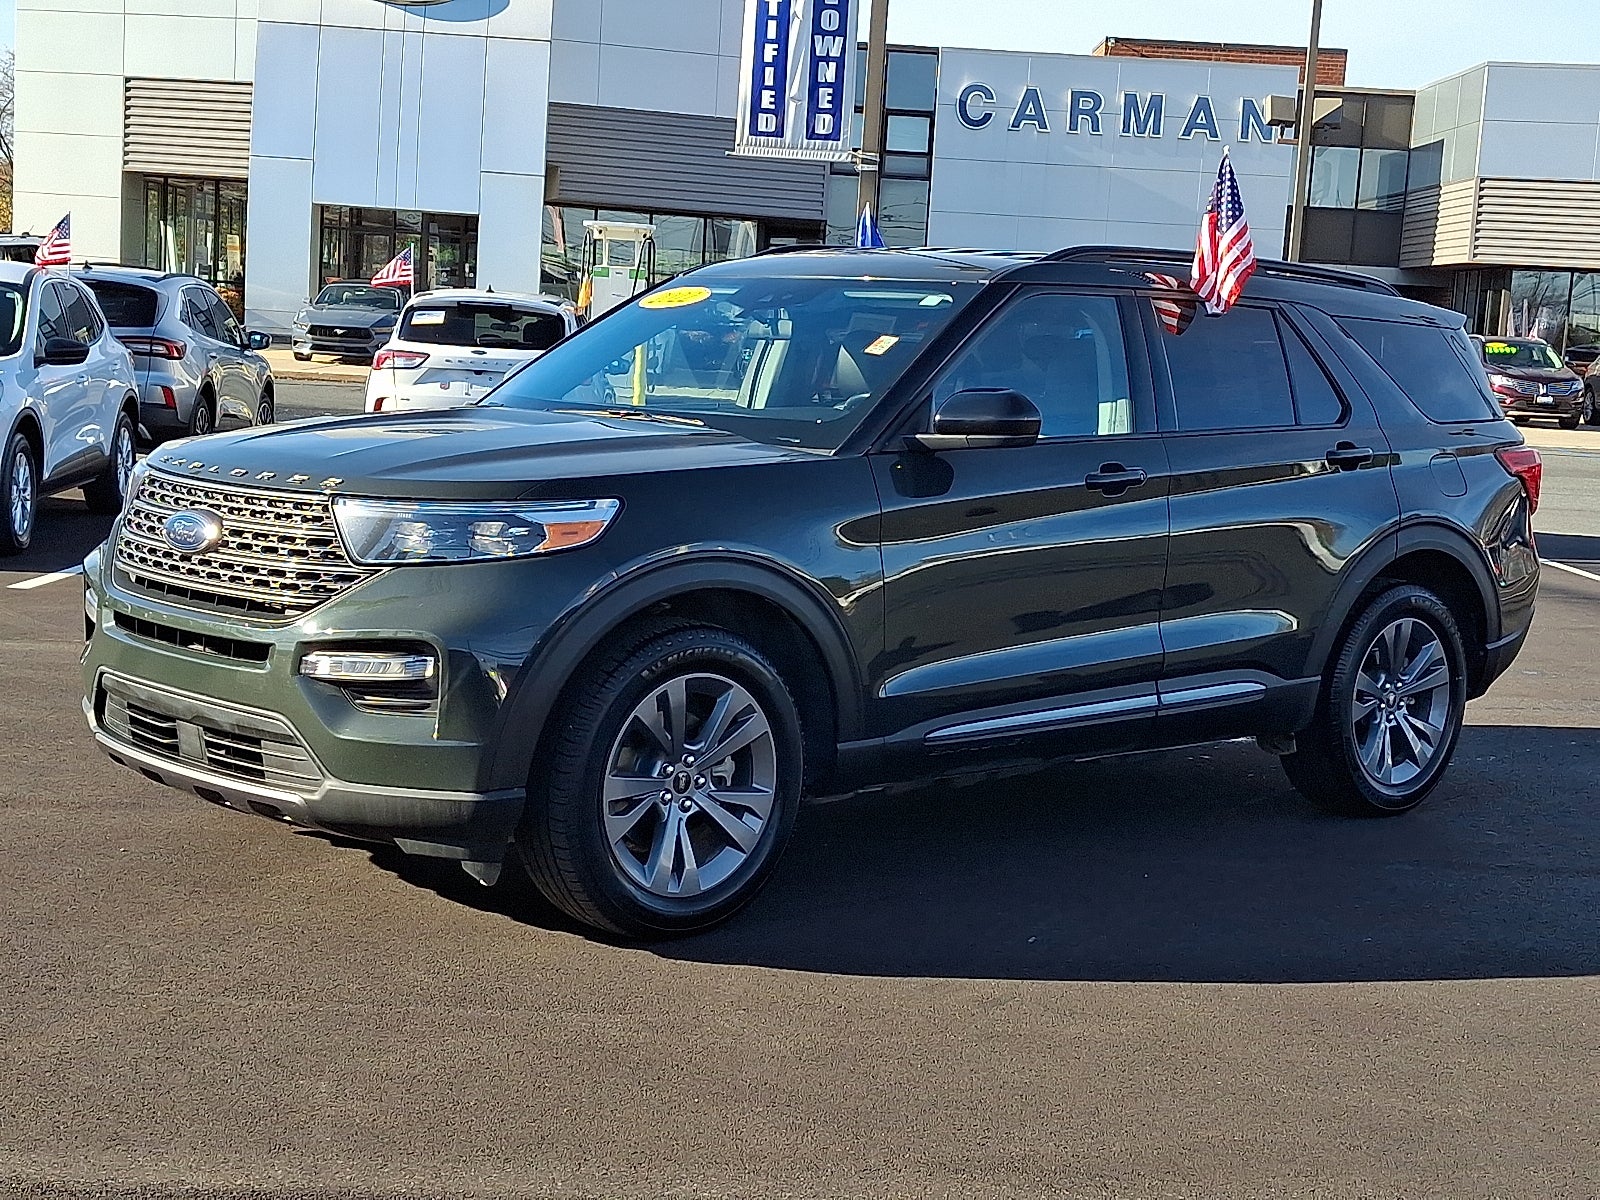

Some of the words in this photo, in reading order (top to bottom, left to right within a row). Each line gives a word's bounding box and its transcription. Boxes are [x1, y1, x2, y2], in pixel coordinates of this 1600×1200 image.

[757, 0, 783, 133] TIFIED
[814, 9, 845, 135] OWNED
[955, 81, 1277, 143] CARMAN
[173, 519, 198, 543] Ford
